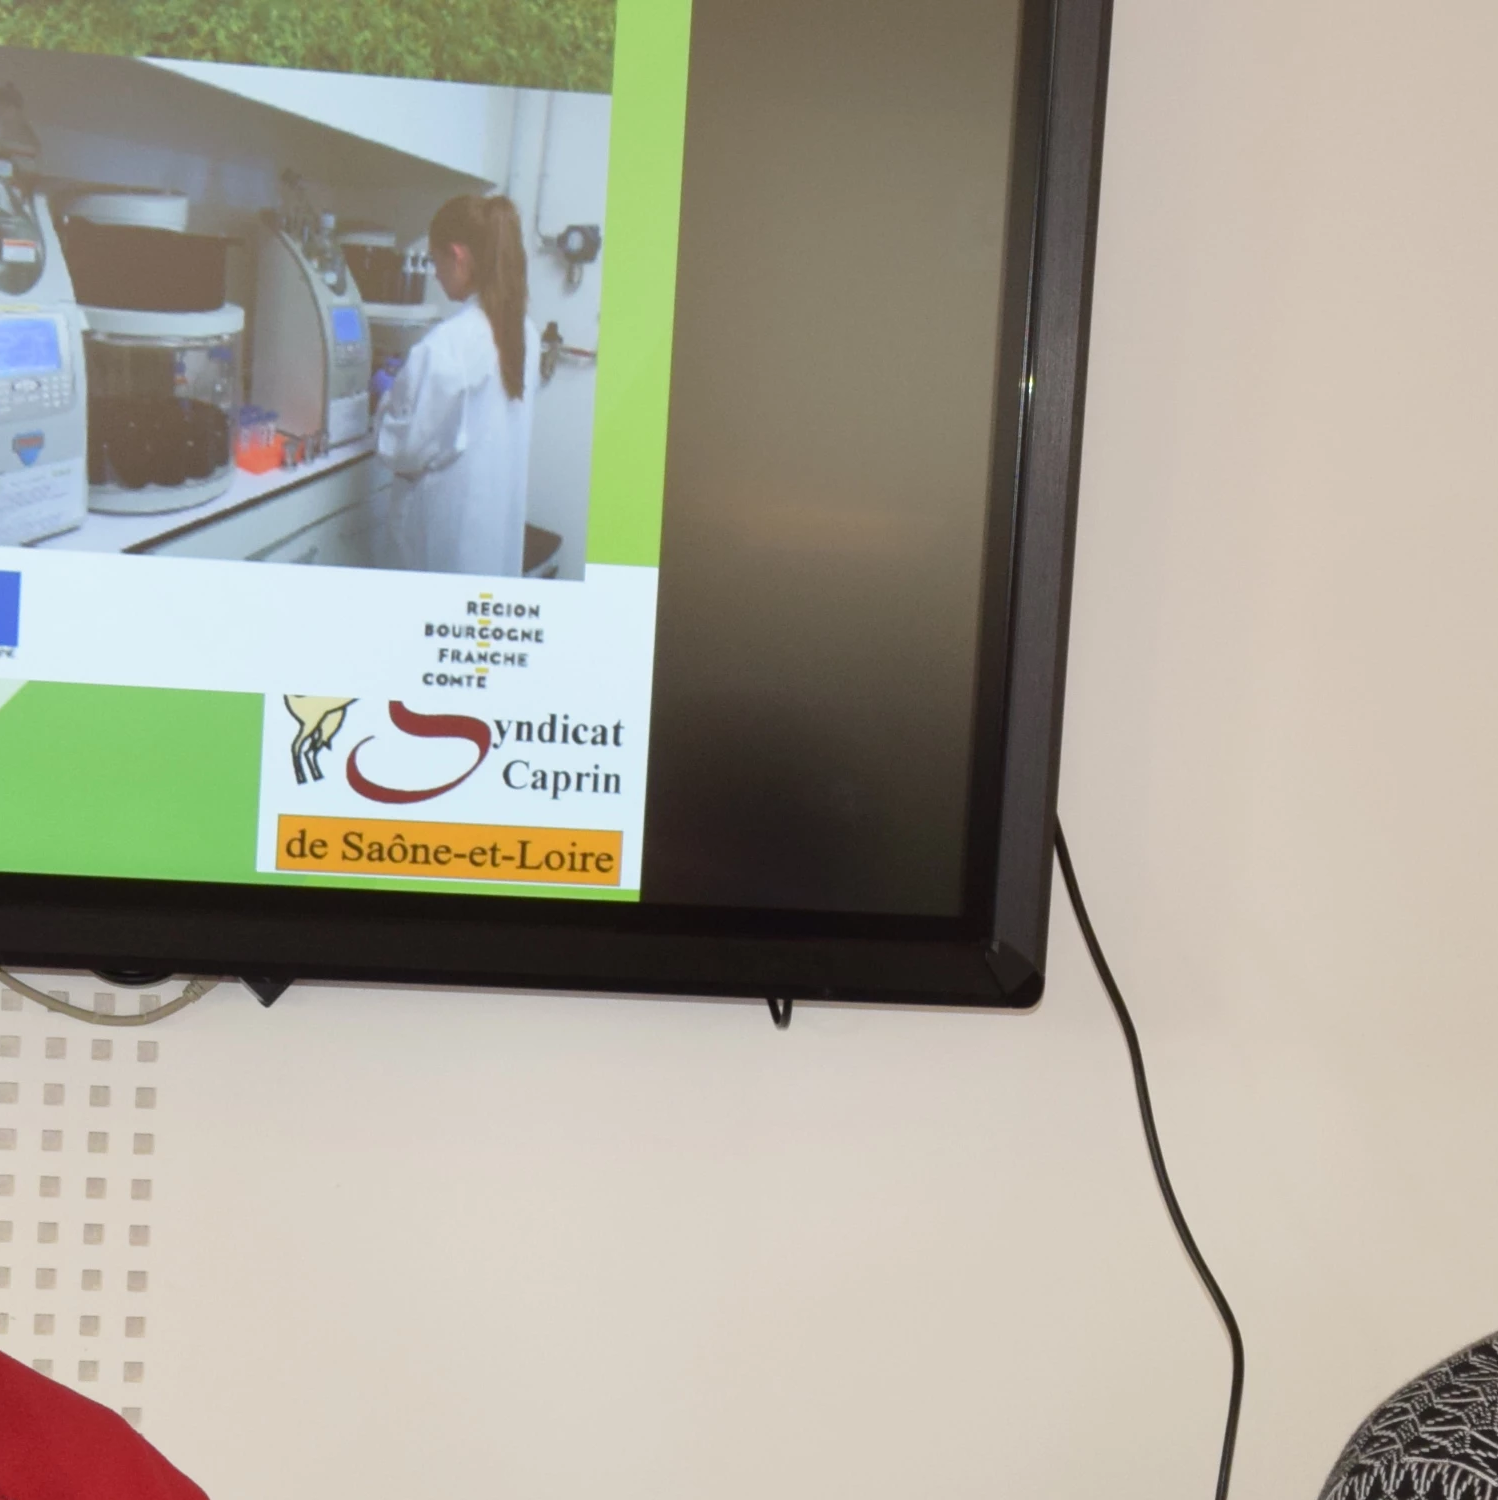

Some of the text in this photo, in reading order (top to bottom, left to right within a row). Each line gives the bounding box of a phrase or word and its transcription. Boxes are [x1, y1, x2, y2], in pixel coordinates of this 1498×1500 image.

[423, 622, 545, 643] BOURGOGNE
[437, 647, 528, 667] FRANCHE
[502, 759, 622, 799] Caprin
[285, 829, 614, 873] de Saône-et-Loire
